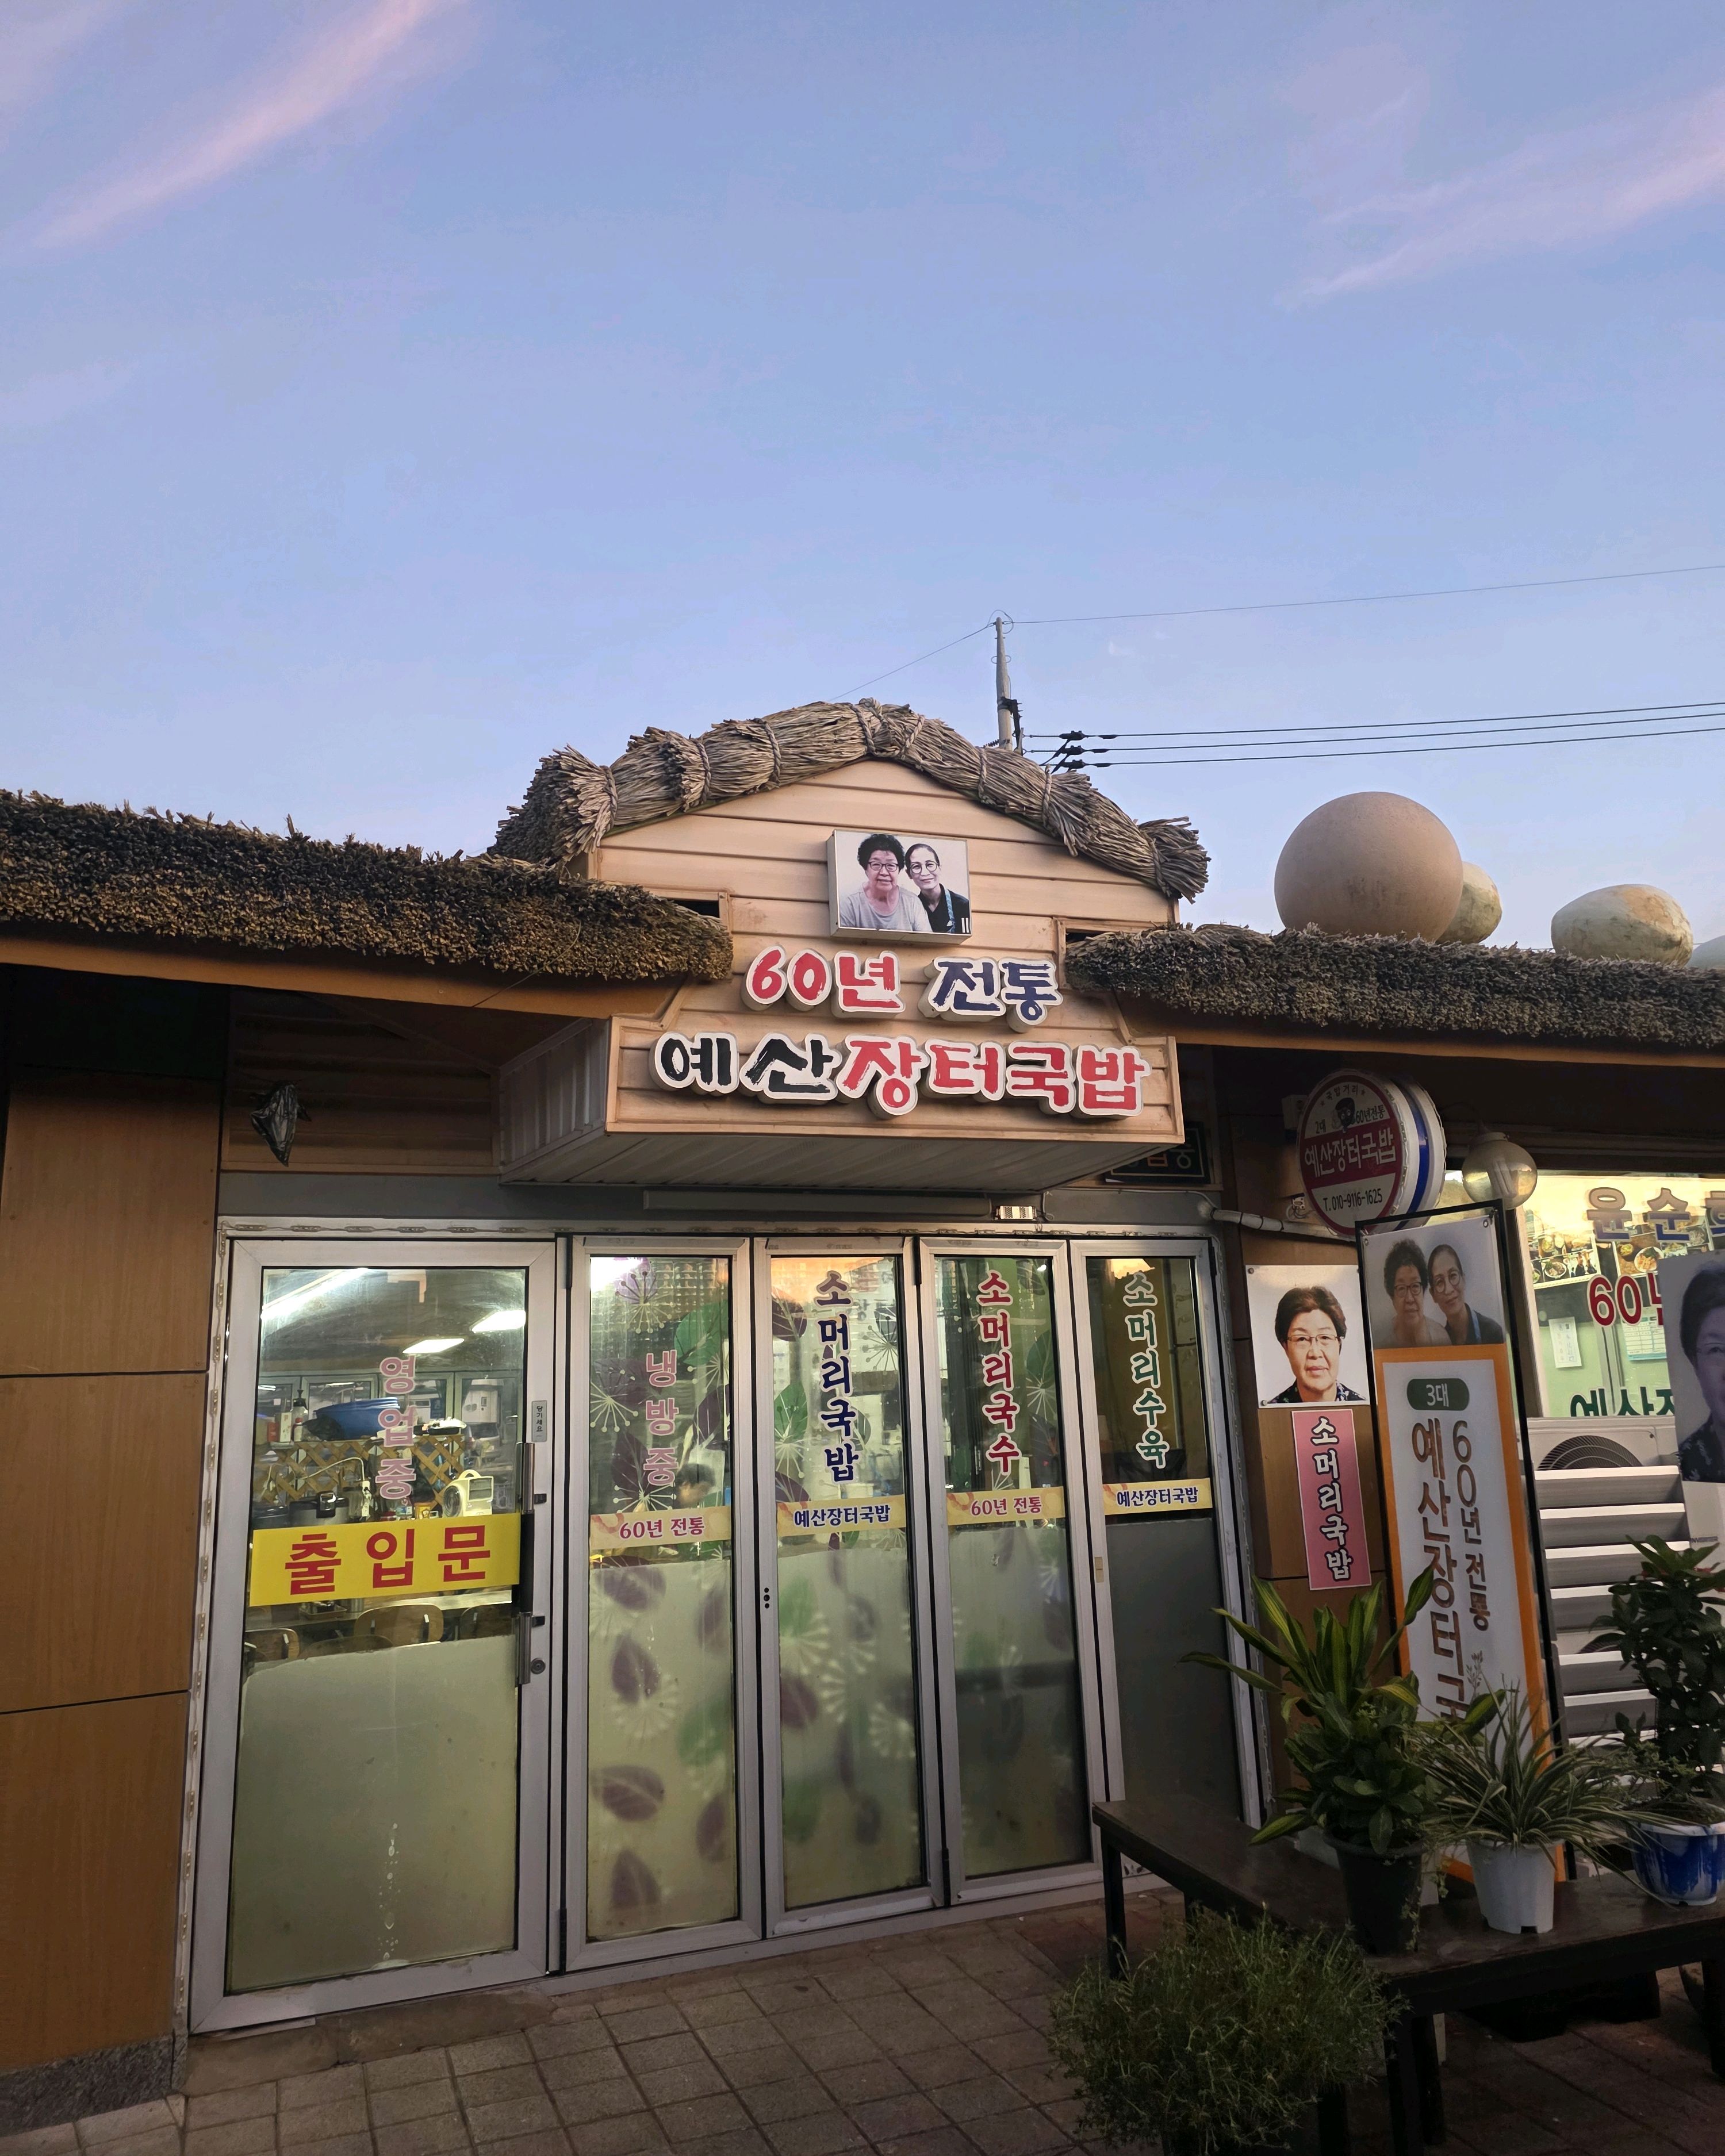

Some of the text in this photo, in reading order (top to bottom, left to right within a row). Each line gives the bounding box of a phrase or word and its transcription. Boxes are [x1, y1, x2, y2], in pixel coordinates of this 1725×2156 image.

[750, 948, 1060, 1022] 60년 전통
[660, 1037, 1146, 1111] 예산장터국밥
[1305, 1127, 1396, 1178] 예산장터국밥
[1316, 1119, 1327, 1134] 2대
[814, 1270, 858, 1484] 소머리국밥
[977, 1270, 1020, 1475] 소머리국수
[1124, 1272, 1170, 1468] 소머리수육
[1427, 1383, 1450, 1407] 3대
[377, 1355, 416, 1499] 영업중
[643, 1349, 678, 1487] 냉방중
[619, 1516, 705, 1539] 60년 전통
[793, 1505, 891, 1528] 예산장터국밥
[971, 1495, 1042, 1517] 60년 전통
[1117, 1487, 1199, 1507] 예산장터국밥
[1310, 1416, 1354, 1582] 소머리국밥
[1452, 1420, 1491, 1632] 60년 전통
[285, 1525, 491, 1595] 출입문
